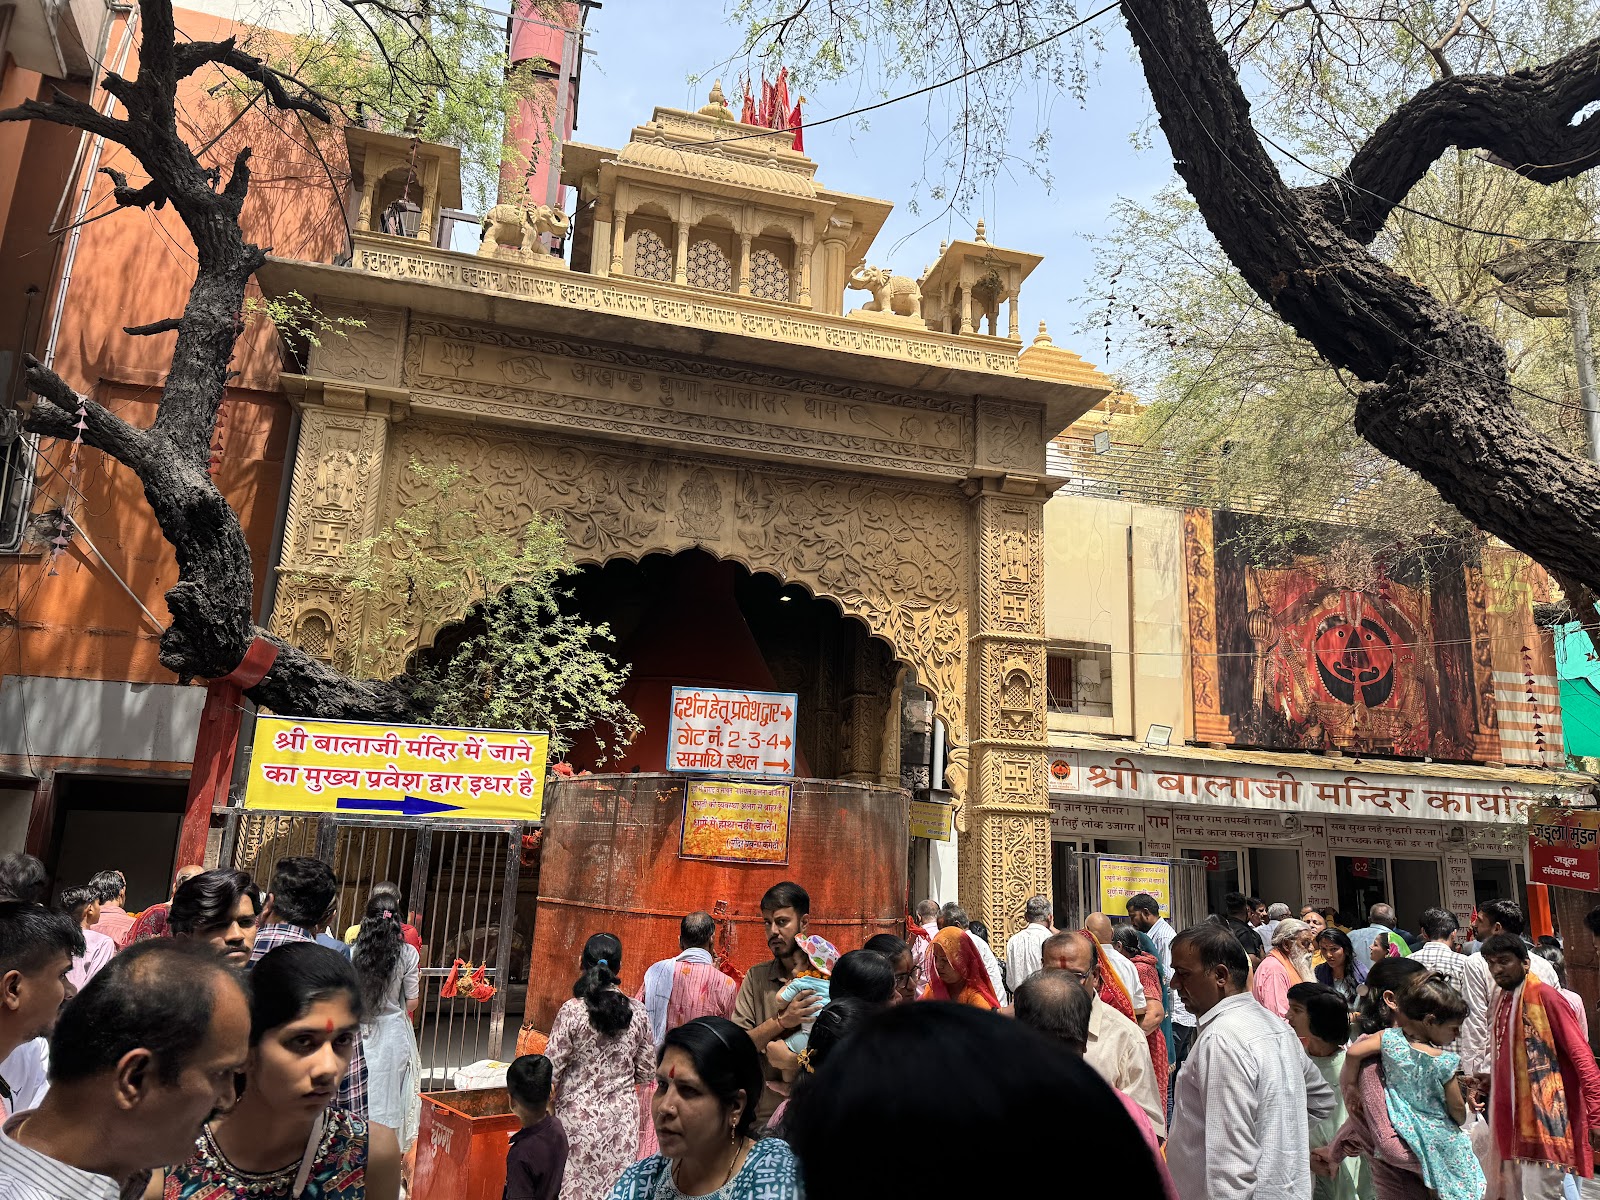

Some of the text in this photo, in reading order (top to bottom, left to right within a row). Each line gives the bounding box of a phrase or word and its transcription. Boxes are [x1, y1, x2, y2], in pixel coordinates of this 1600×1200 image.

[674, 692, 709, 720] दर्शन
[731, 694, 761, 722] प्रवेश
[760, 703, 781, 726] द्वार
[676, 722, 707, 746] गेट
[276, 728, 532, 762] श्री बालाजी मंदिर में जाने
[676, 748, 759, 770] समाधि स्थल
[264, 765, 533, 796] का मुख्य प्रवेश द्वार इधर है
[1087, 758, 1144, 791] श्री
[1152, 771, 1302, 803] बालाजी
[1311, 776, 1414, 813] मन्दिर
[1081, 818, 1103, 829] लोक
[1147, 816, 1169, 829] राम
[1175, 814, 1191, 822] सब
[1193, 815, 1204, 823] पर
[1206, 816, 1222, 824] राम
[1206, 828, 1228, 837] काज
[1230, 831, 1254, 839] सकल
[1256, 832, 1269, 841] तुम
[1331, 823, 1346, 831] सब
[1348, 824, 1366, 834] सुख
[1329, 835, 1343, 845] तुम
[1410, 840, 1421, 848] डर
[1354, 862, 1368, 872] C-2
[1542, 865, 1570, 877] संस्कार
